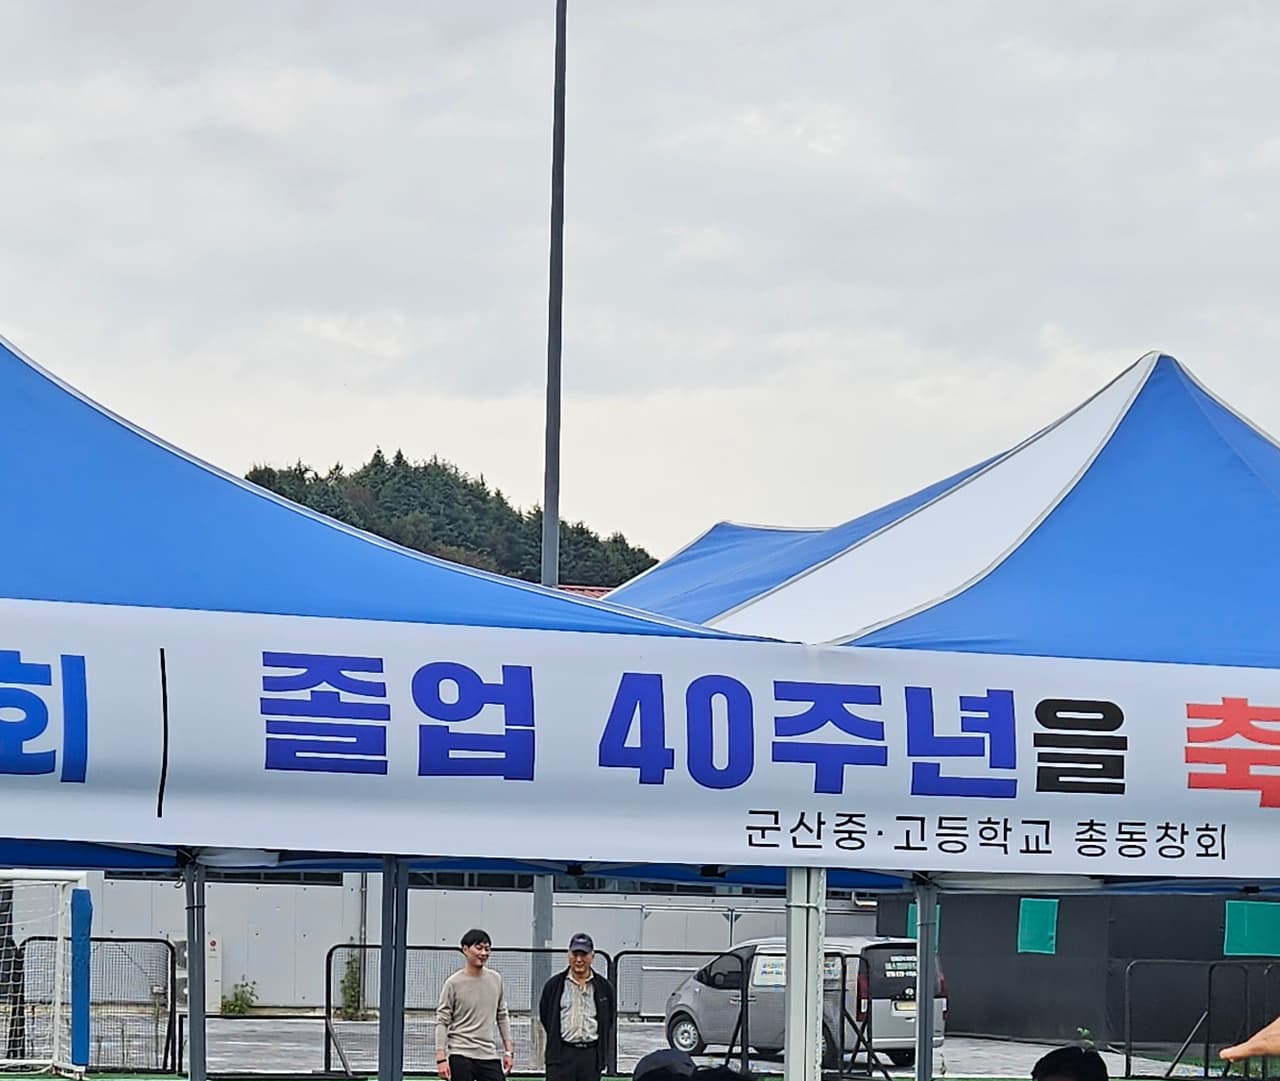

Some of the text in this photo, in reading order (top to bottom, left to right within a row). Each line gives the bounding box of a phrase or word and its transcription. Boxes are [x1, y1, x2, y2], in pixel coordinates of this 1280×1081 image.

[259, 650, 535, 783] 졸업
[598, 672, 1129, 800] 40주년을
[744, 808, 1229, 862] 군산중·고등학교 총동창회
